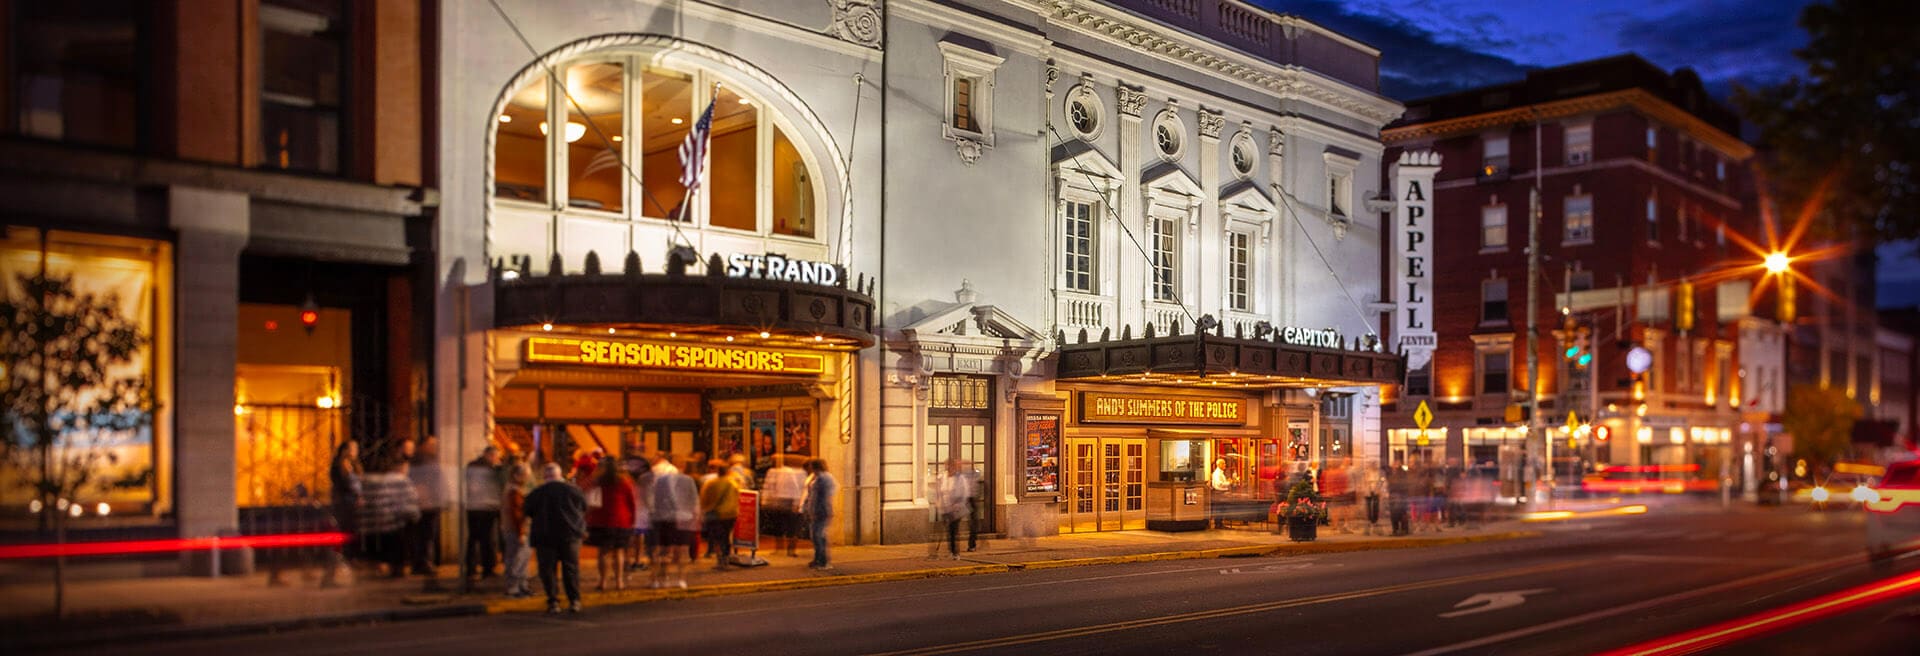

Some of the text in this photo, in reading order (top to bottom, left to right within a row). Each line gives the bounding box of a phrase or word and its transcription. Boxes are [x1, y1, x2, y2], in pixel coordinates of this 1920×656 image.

[1405, 180, 1425, 329] APPELL
[728, 253, 837, 287] STRAND
[1284, 326, 1340, 349] CAPITOL
[1401, 335, 1435, 346] CENTER
[579, 340, 784, 371] SEASON SPONSORS
[957, 359, 978, 369] EXIT
[1096, 398, 1238, 419] ANDY SUMMERS OF THE POLICE
